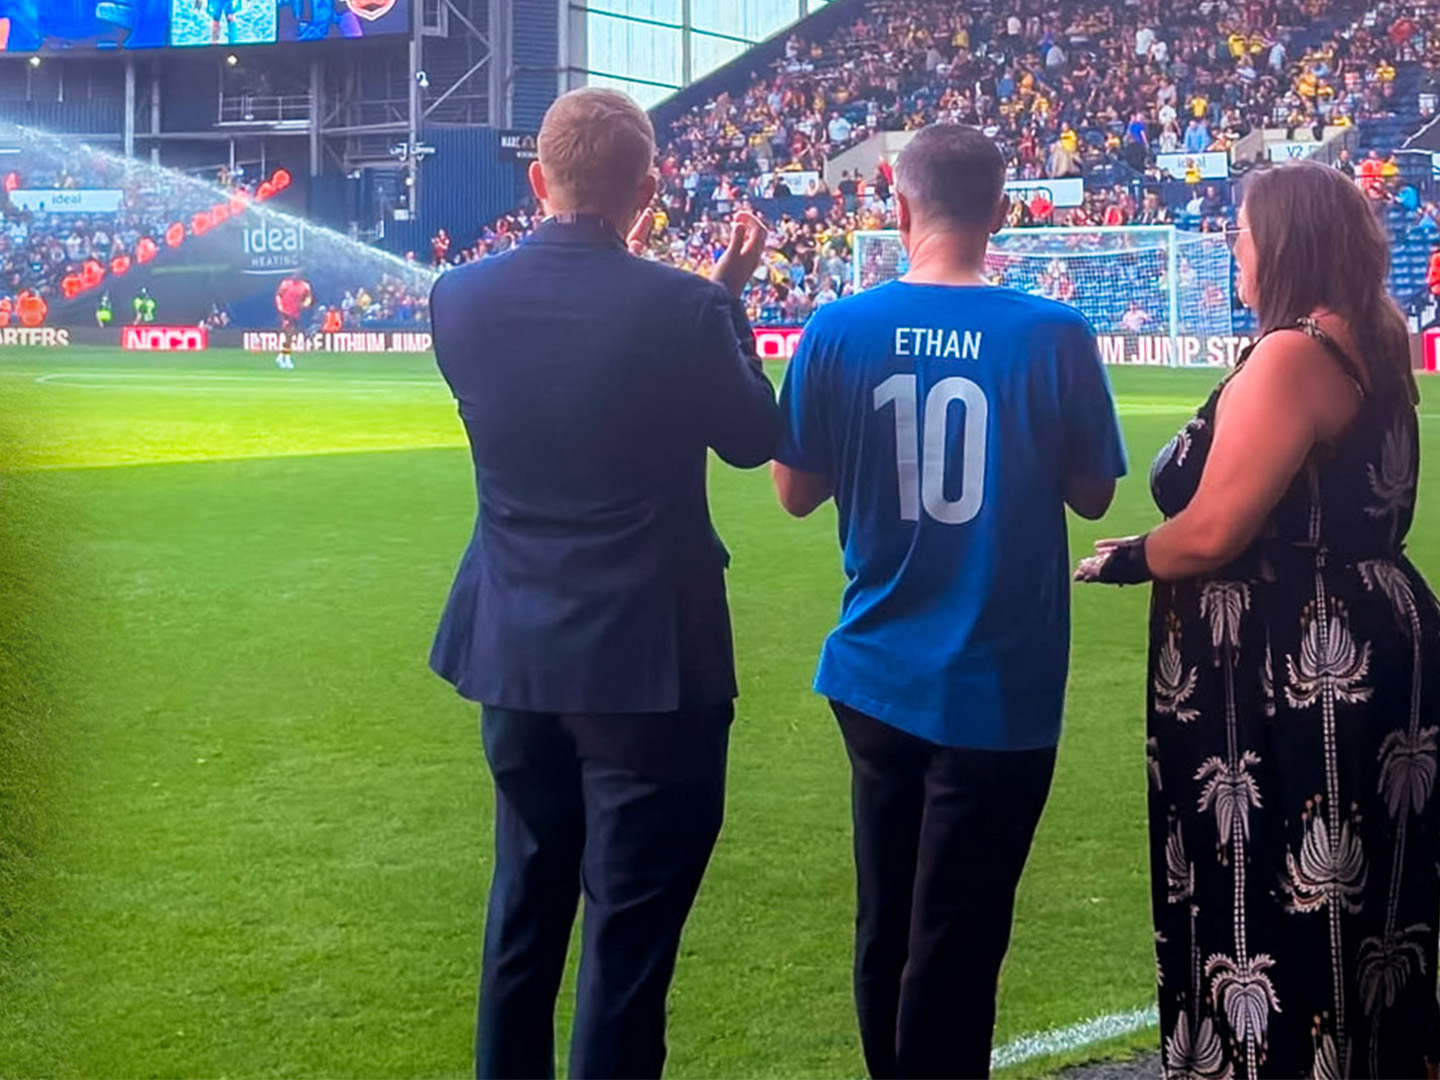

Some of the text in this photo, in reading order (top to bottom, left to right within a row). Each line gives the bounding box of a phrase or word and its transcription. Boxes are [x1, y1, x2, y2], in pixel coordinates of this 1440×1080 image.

[243, 218, 304, 254] ideal
[127, 330, 202, 351] NOCO
[895, 327, 982, 360] ETHAN
[873, 374, 988, 525] 10
